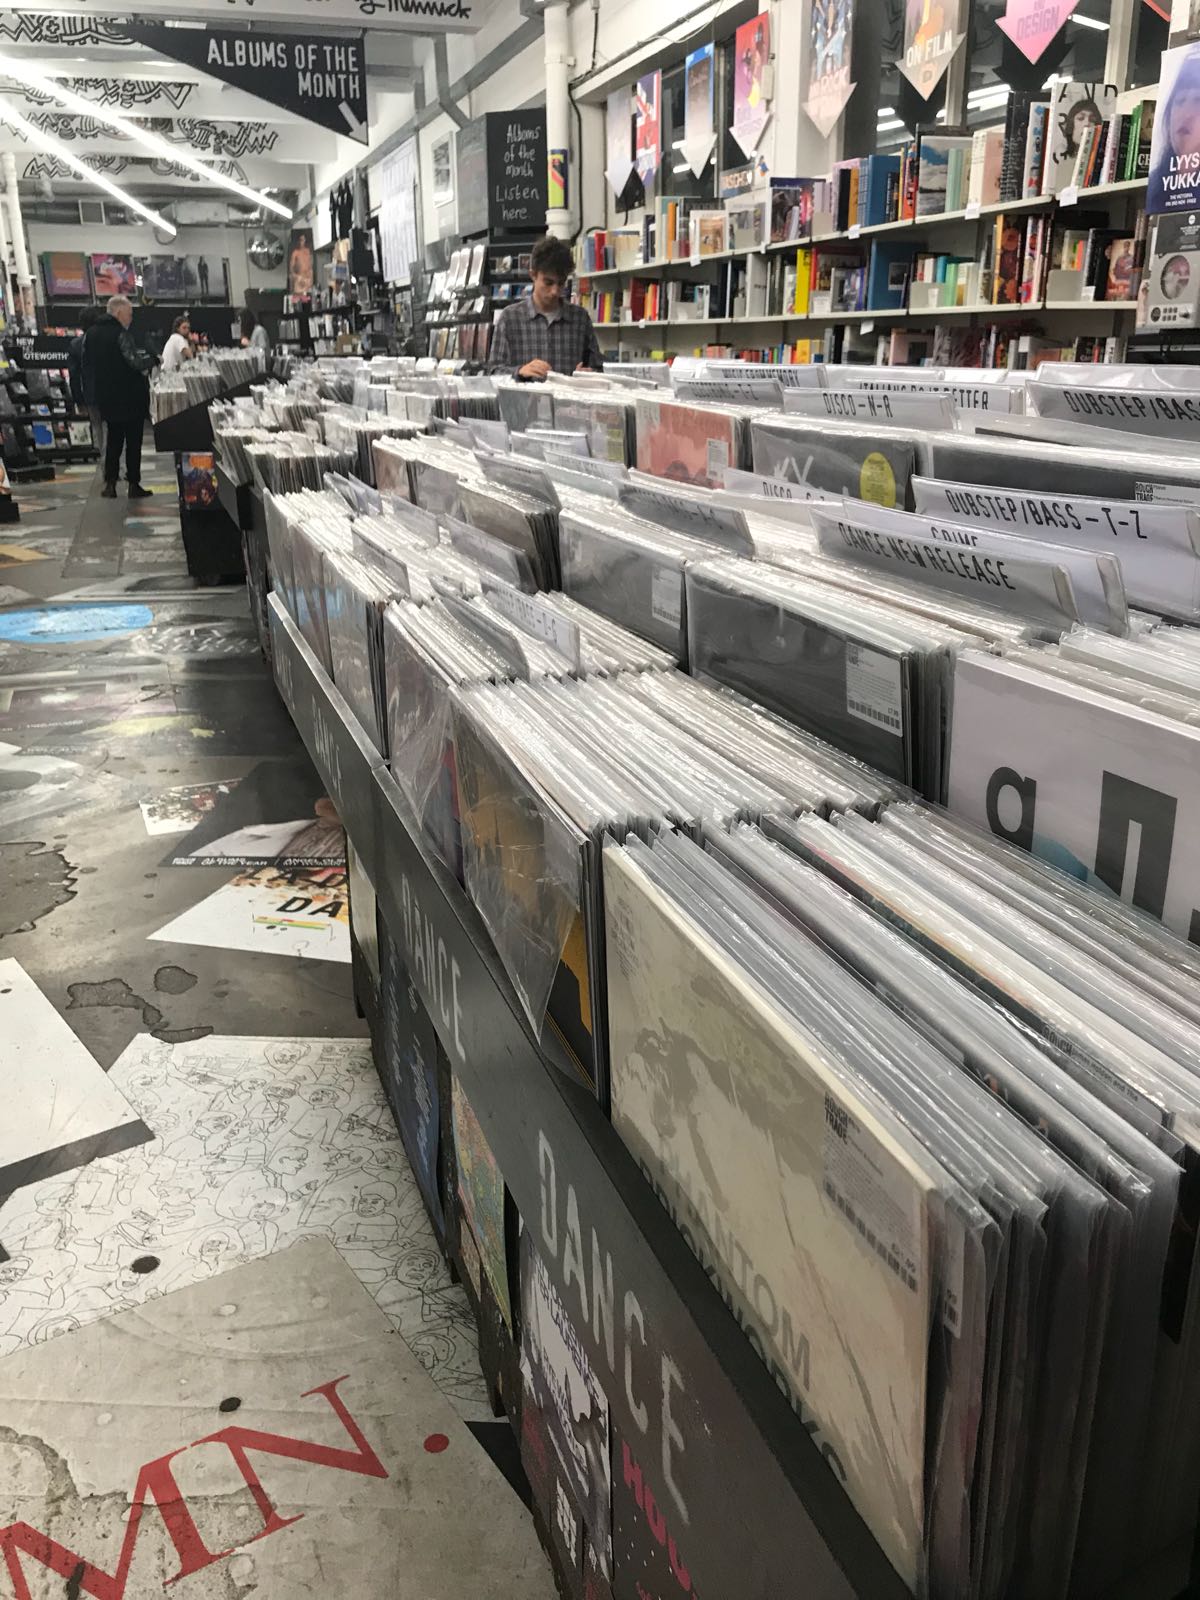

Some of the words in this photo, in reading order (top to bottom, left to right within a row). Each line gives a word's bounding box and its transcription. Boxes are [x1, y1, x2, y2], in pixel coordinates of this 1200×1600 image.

[1016, 11, 1059, 40] DESIGN
[207, 38, 288, 68] ALBUMS
[295, 44, 317, 72] OF
[324, 46, 358, 72] THE
[906, 47, 921, 67] ON
[925, 31, 952, 60] FILM
[298, 71, 361, 99] MONTH
[506, 123, 541, 144] Albums
[503, 144, 515, 163] of
[518, 143, 536, 161] the
[495, 184, 540, 202] Listen
[502, 204, 528, 221] here
[16, 337, 35, 346] NEW
[838, 522, 889, 556] DANCE
[887, 536, 927, 571] NEW
[925, 545, 1017, 592] RELEASE
[401, 872, 467, 1064] DANCE
[538, 1128, 691, 1526] DANCE
